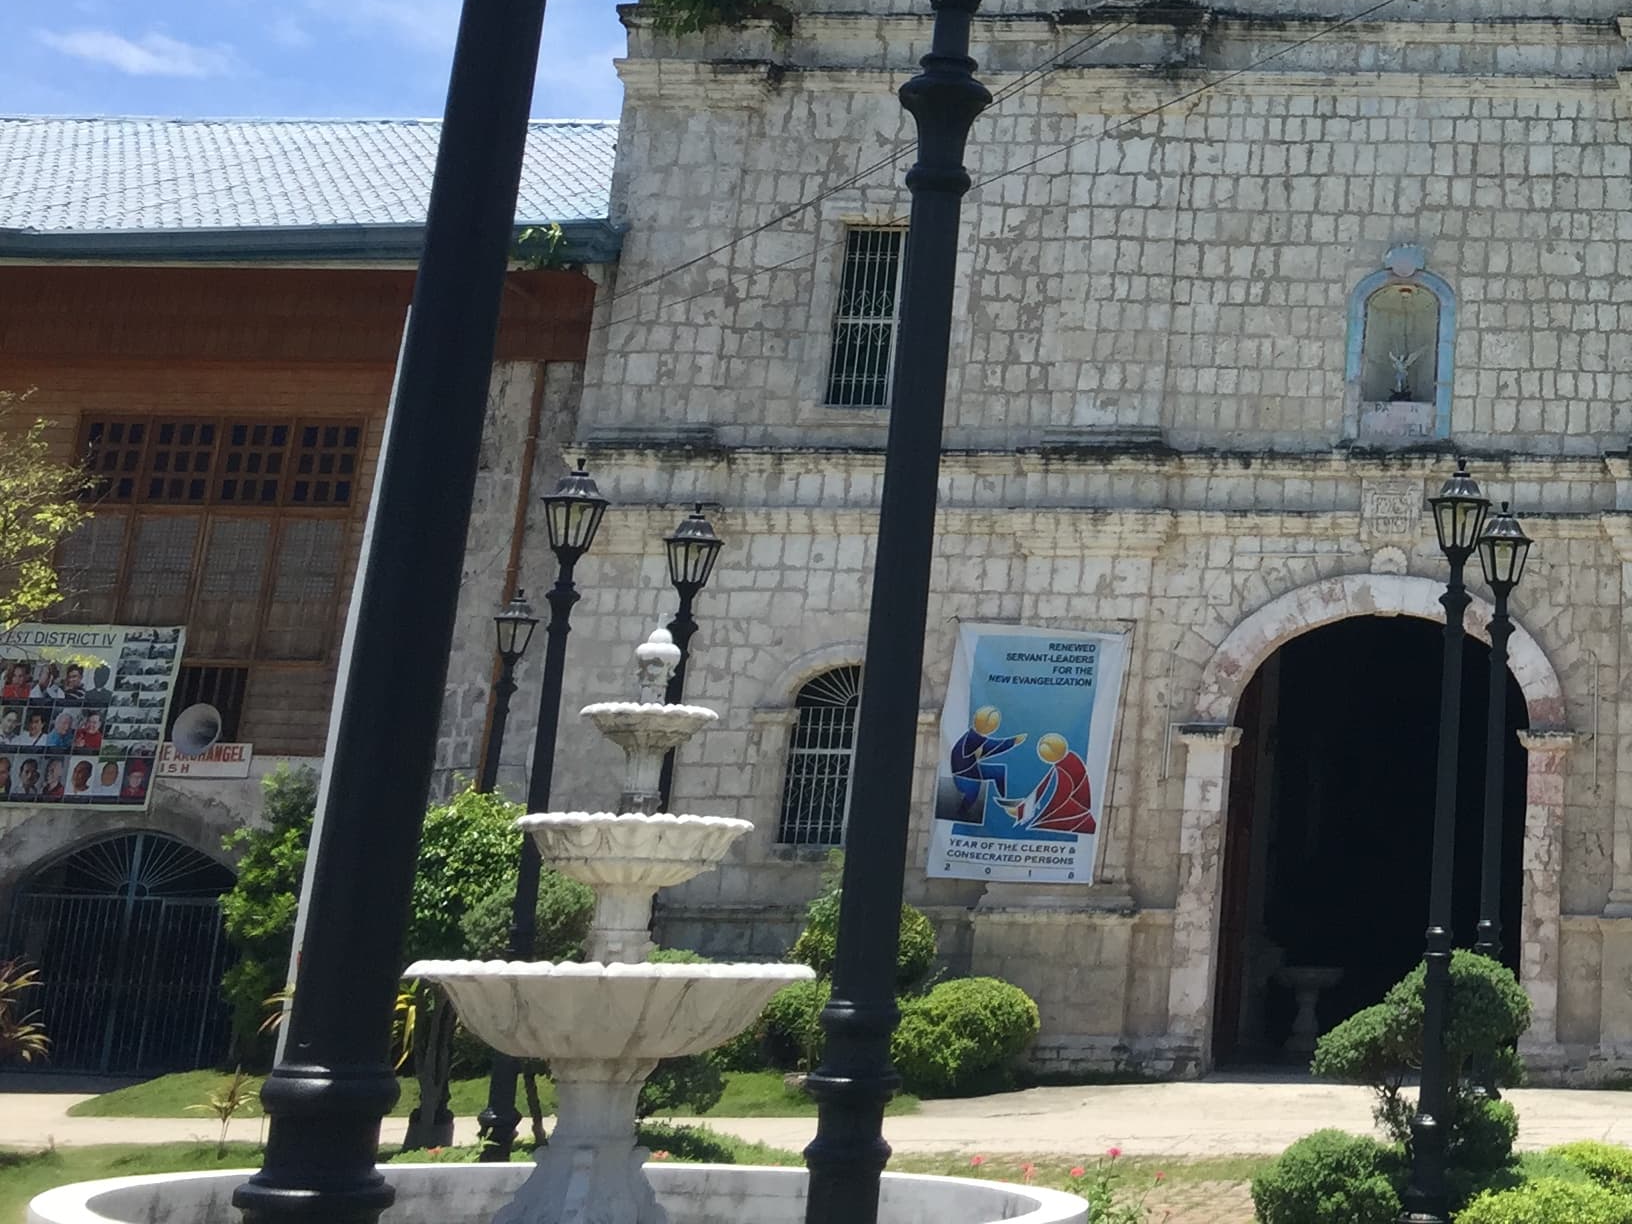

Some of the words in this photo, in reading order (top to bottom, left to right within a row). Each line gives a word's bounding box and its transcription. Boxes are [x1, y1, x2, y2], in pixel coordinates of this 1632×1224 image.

[34, 631, 100, 645] DISTRICT
[102, 633, 117, 646] IV
[1049, 643, 1096, 653] RENEWED
[1006, 652, 1095, 664] SERVANT-LEADERS
[1052, 665, 1073, 675] FOR
[1075, 666, 1093, 676] THE
[988, 674, 1011, 684] NEW
[1012, 676, 1092, 687] EVANGELIZATION
[949, 838, 978, 849] YEAR
[981, 841, 995, 850] OF
[997, 842, 1018, 852] THE
[1020, 844, 1067, 854] CLERGY
[1068, 846, 1076, 854] &
[946, 849, 1022, 863] CONSECRATED
[1024, 855, 1074, 865] PERSONS
